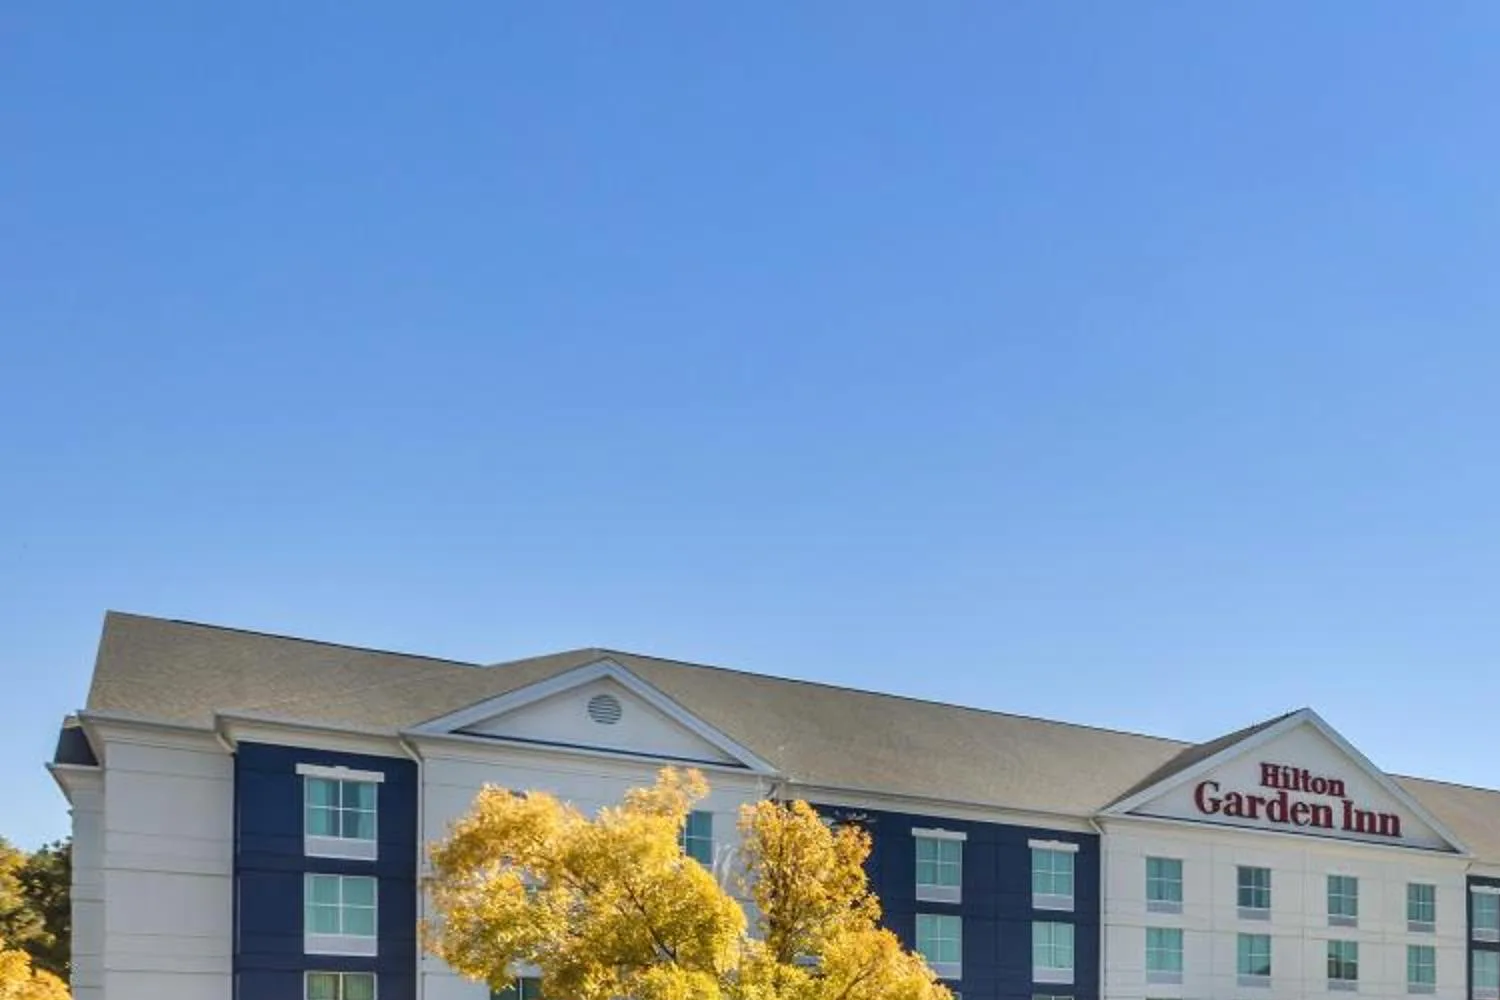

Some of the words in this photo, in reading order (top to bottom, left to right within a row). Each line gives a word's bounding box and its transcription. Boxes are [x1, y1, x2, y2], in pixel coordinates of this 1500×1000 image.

[1260, 763, 1346, 797] Hilton
[1194, 780, 1334, 829] Garden
[1342, 800, 1402, 837] Inn
